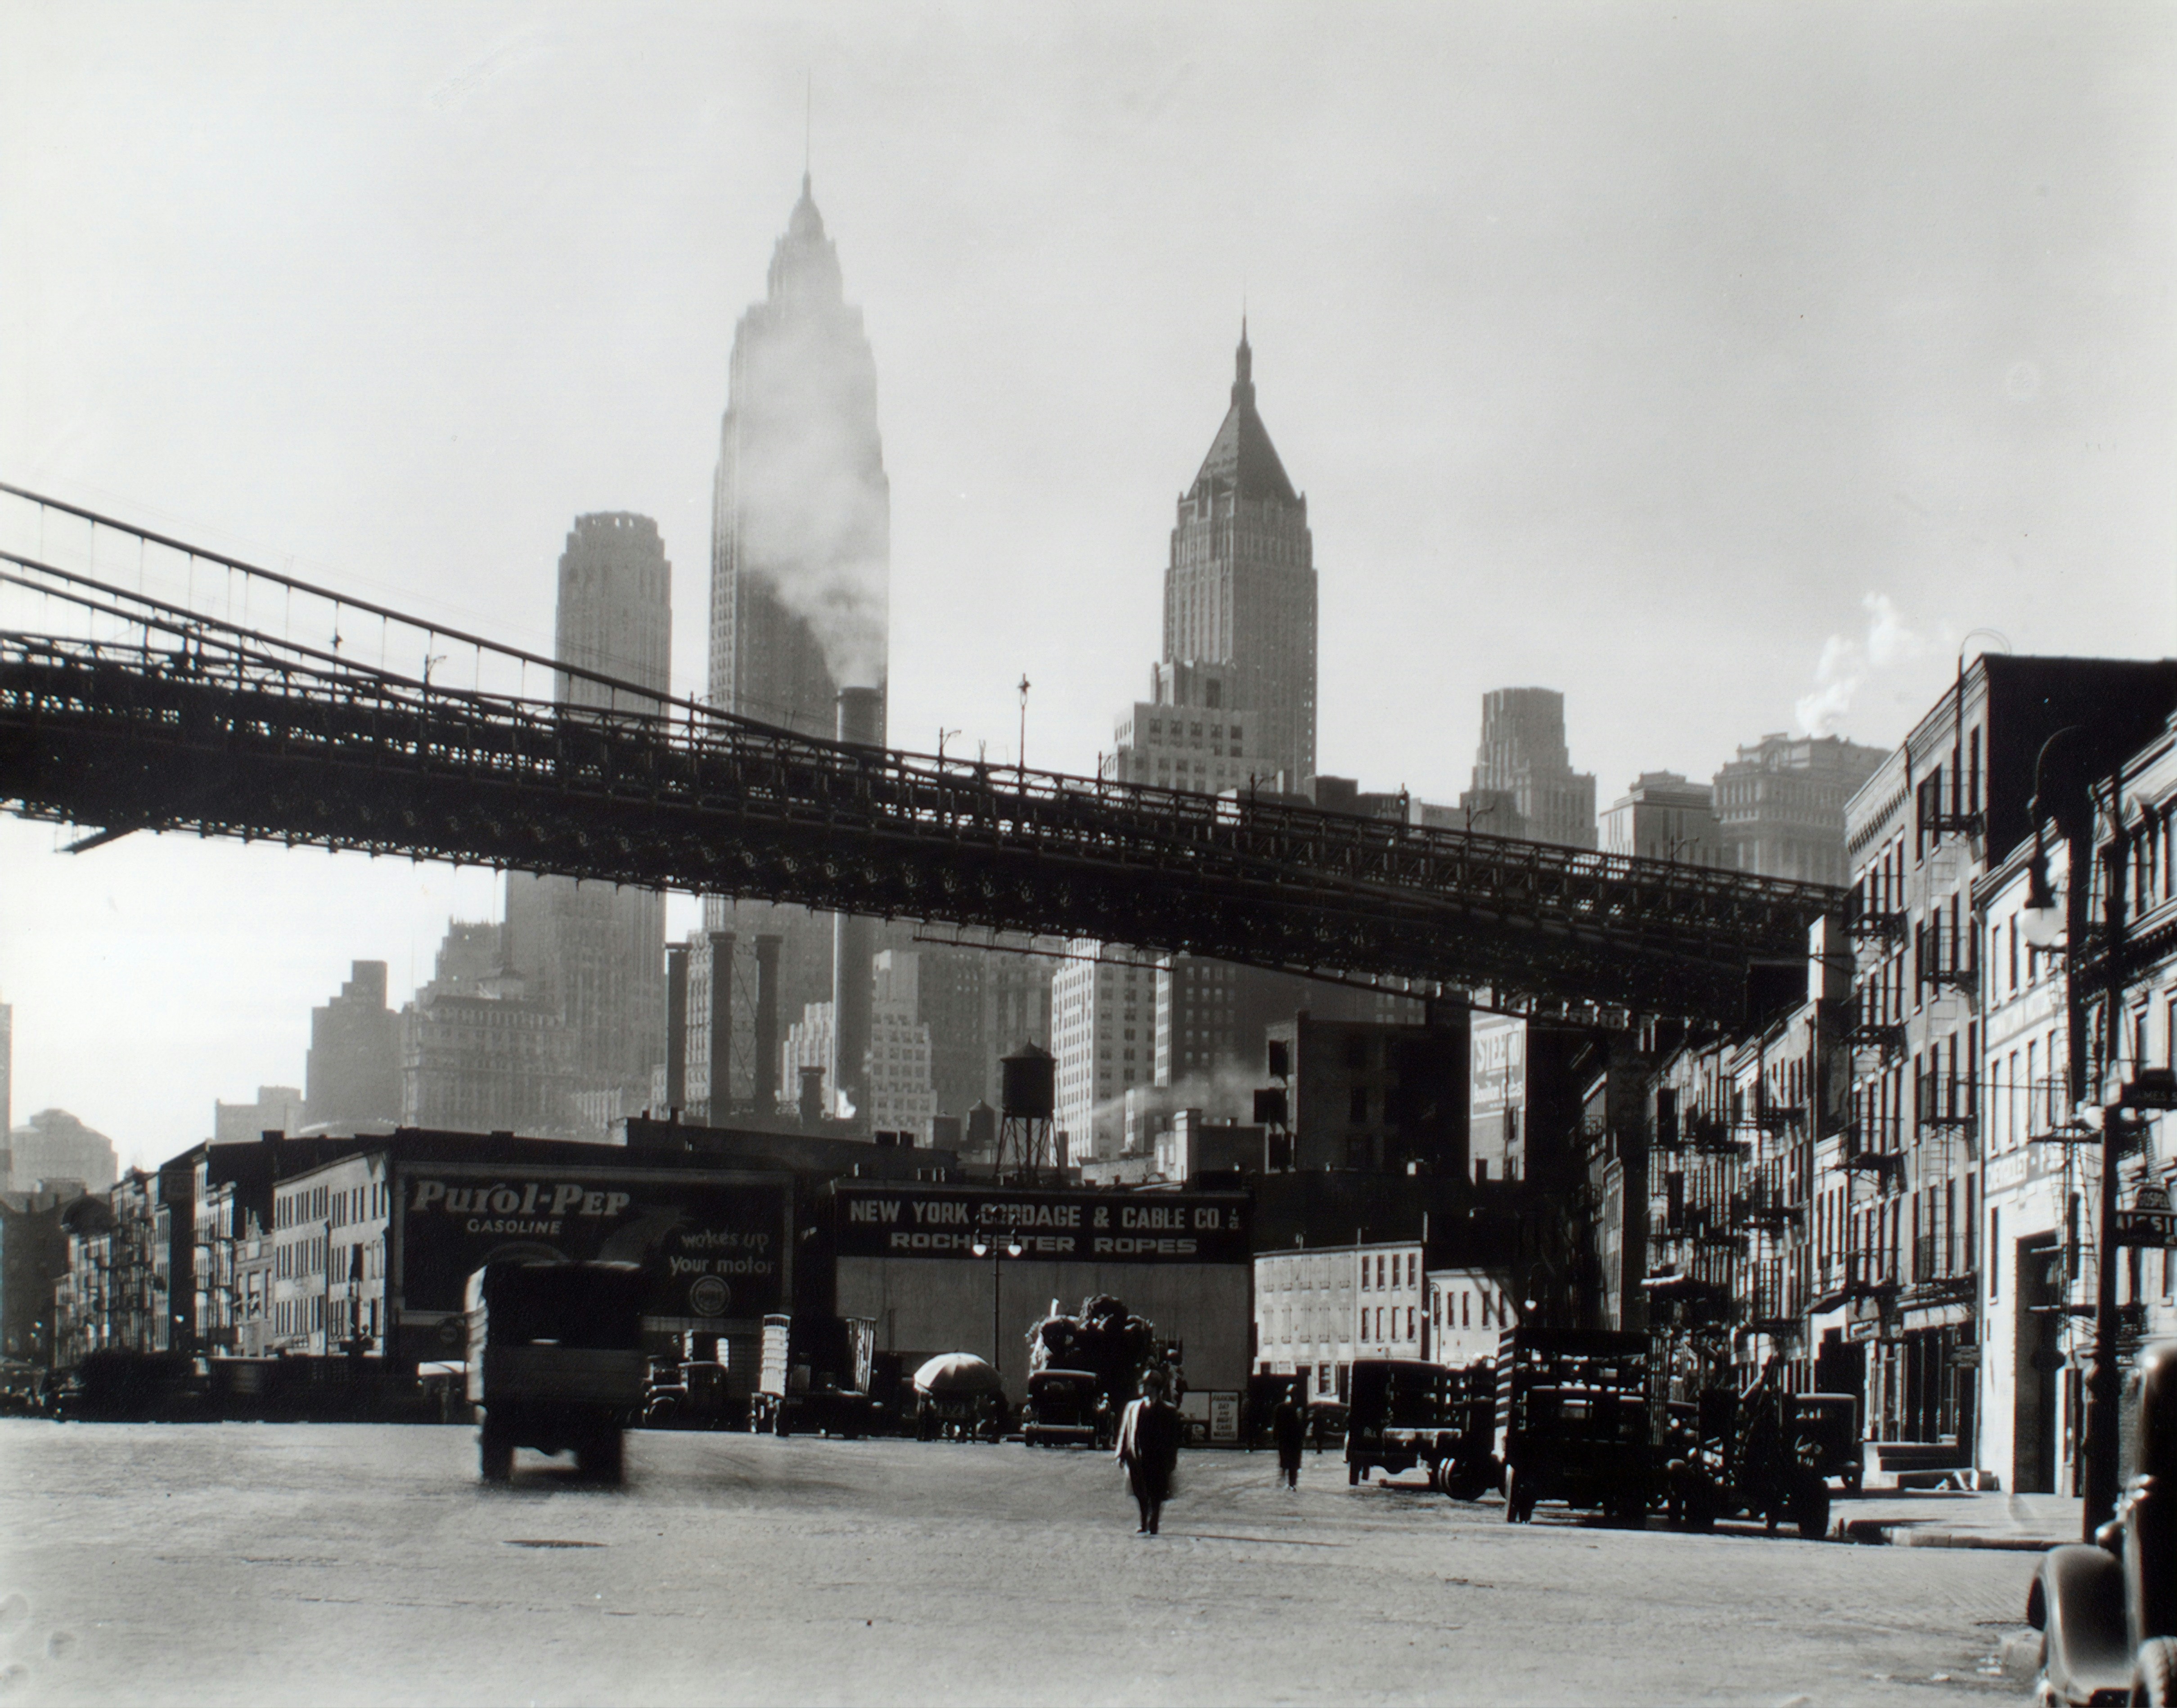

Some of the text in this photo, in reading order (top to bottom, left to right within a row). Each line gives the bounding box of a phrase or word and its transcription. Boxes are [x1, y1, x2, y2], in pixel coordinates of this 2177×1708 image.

[2138, 1191, 2169, 1208] GOSPEL
[850, 1200, 901, 1223] NEW
[912, 1202, 969, 1224] YORK
[1093, 1206, 1110, 1228] &
[1122, 1206, 1185, 1229] CABLE
[467, 1218, 562, 1235] GASOLINE
[743, 1232, 769, 1253] up
[891, 1232, 1197, 1254] ROCHESTER ROPES
[670, 1256, 774, 1276] your motor
